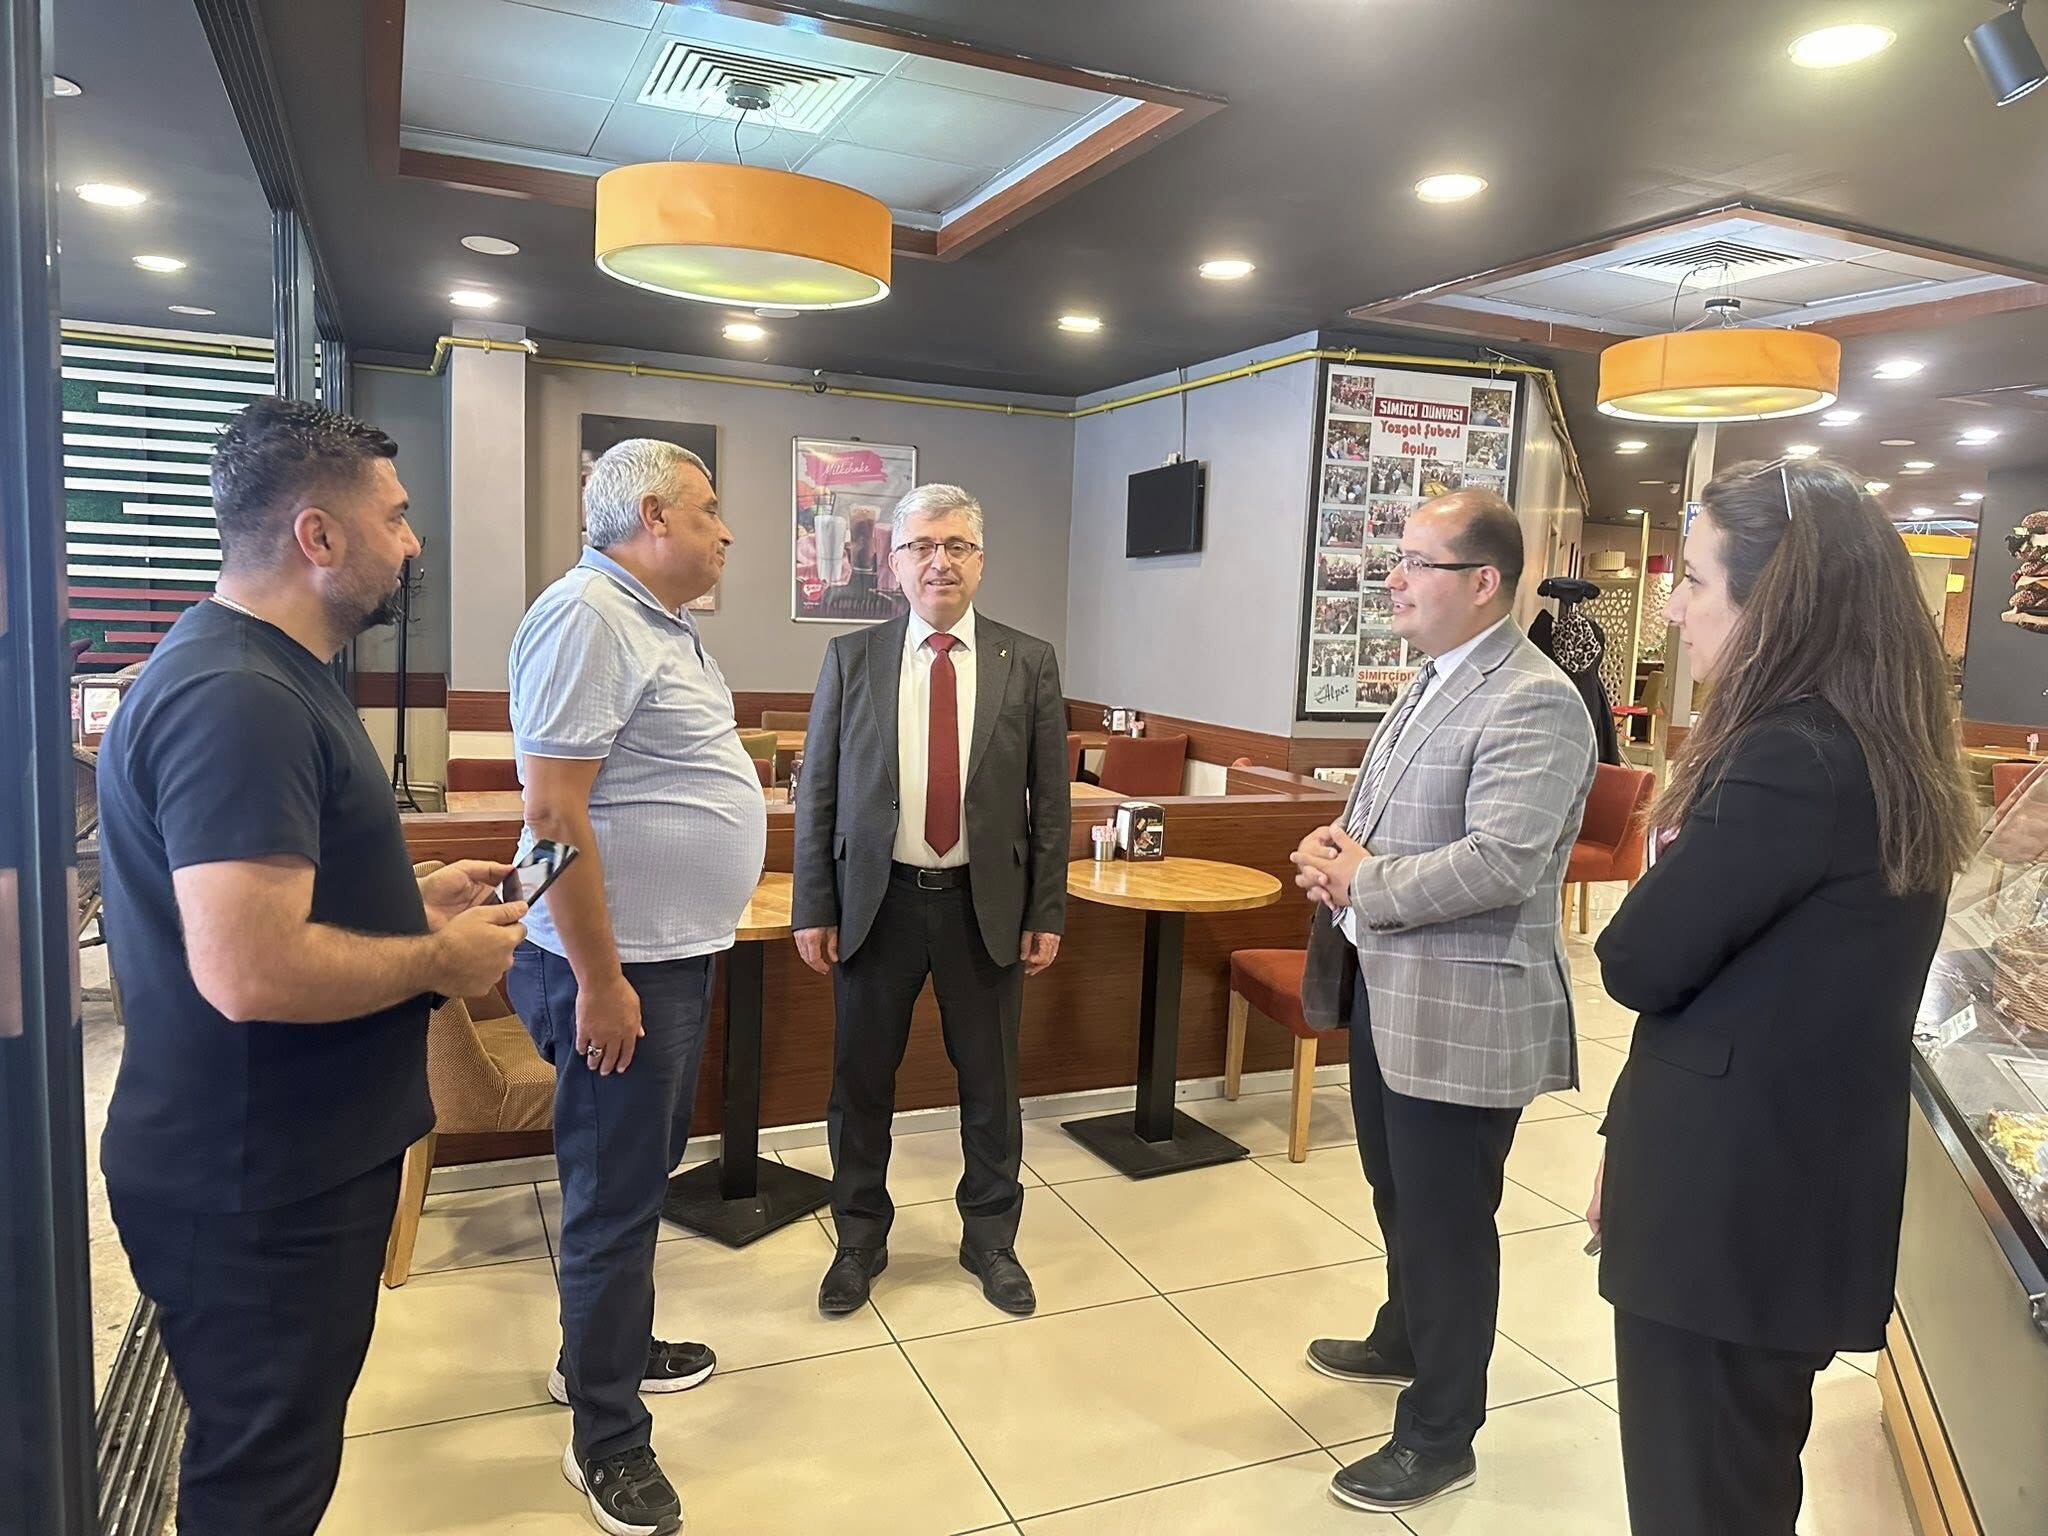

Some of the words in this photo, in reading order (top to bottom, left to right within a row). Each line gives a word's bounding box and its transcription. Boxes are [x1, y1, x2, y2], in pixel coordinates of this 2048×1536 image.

[1421, 403, 1464, 422] DÜNYASI
[1380, 420, 1421, 438] Yozgat
[1424, 423, 1461, 439] Şubesi
[821, 461, 871, 476] Milkshake
